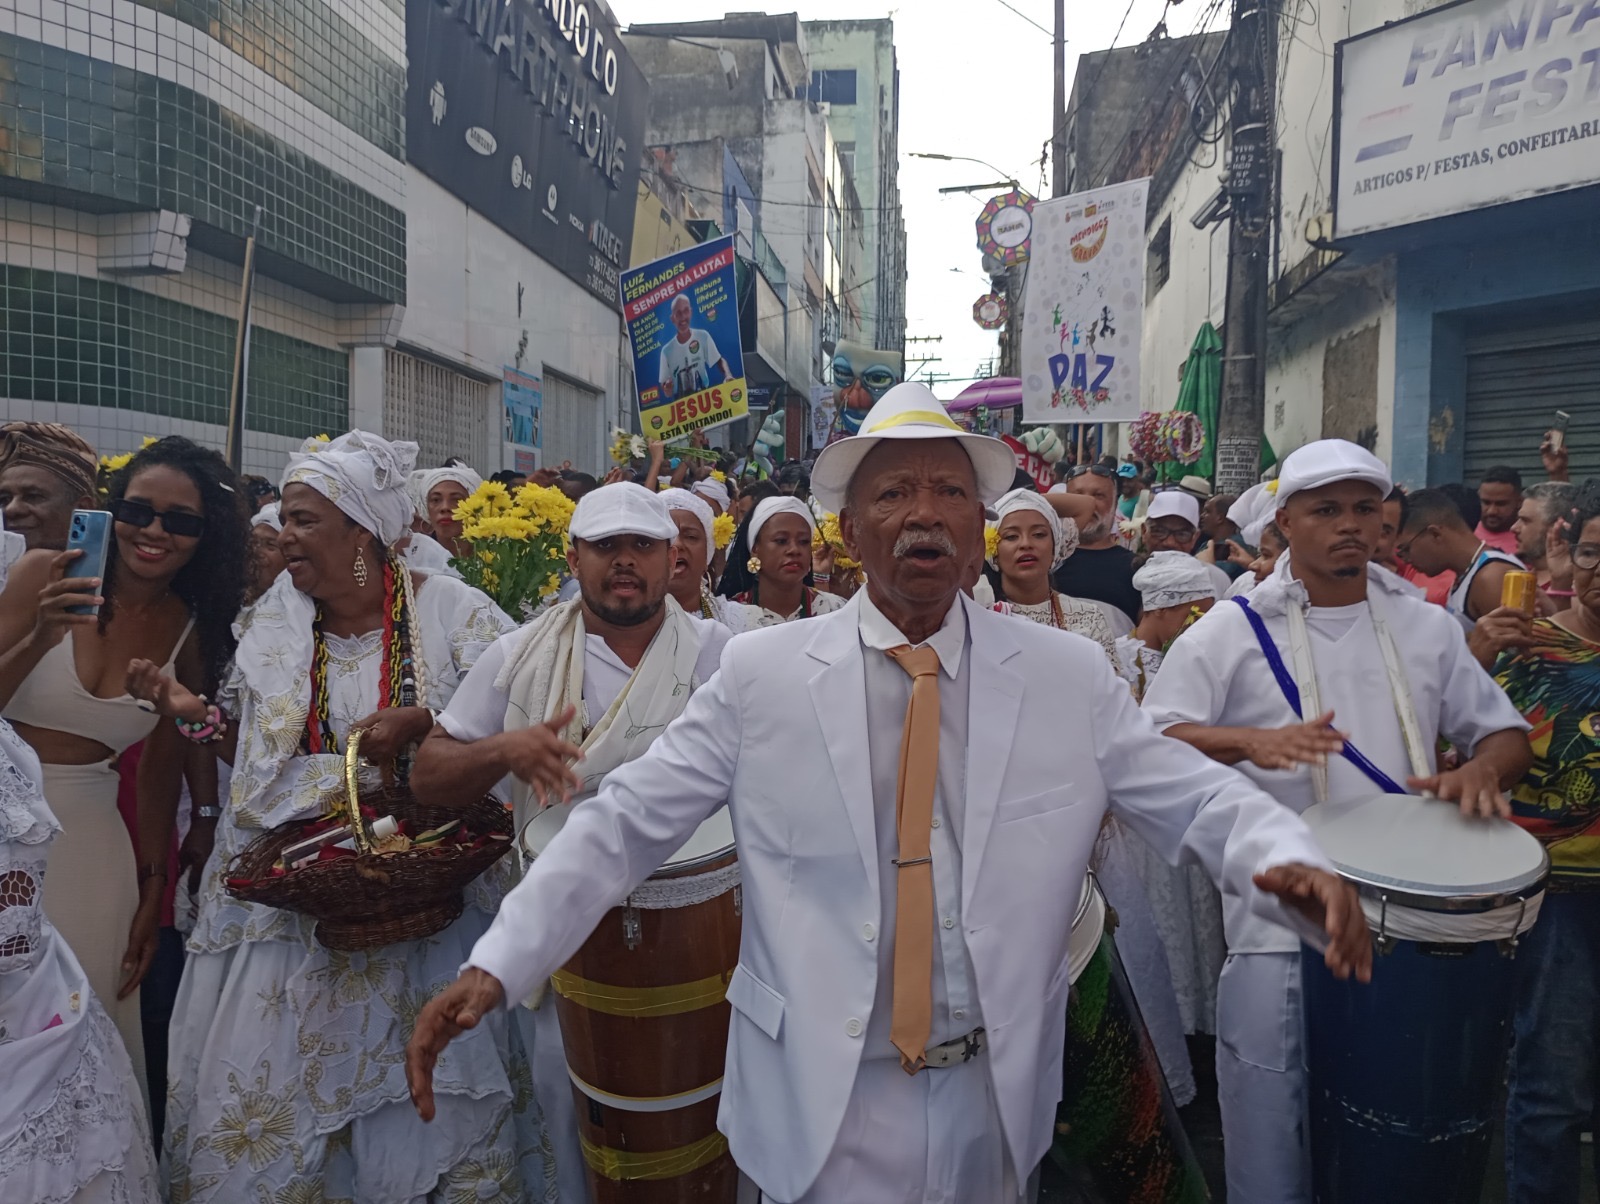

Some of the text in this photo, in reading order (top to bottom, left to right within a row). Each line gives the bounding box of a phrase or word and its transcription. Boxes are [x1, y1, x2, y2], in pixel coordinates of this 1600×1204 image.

[440, 0, 627, 190] MARTPHONE
[470, 126, 494, 153] SAMSUNG
[1353, 119, 1600, 196] ARTIGOS P/ FESTAS, CONFEITARI
[522, 167, 532, 190] LG
[624, 272, 645, 292] LUIZ
[626, 262, 685, 302] FERNANDES
[633, 254, 726, 315] SEMPRE NA LUTA!
[694, 277, 722, 296] Itabuna
[636, 323, 664, 344] FEVEREIRO
[1048, 353, 1115, 393] PAZ
[660, 425, 682, 442] ESTÁ
[683, 408, 733, 434] VOLTANDO!
[667, 389, 723, 427] JESUS
